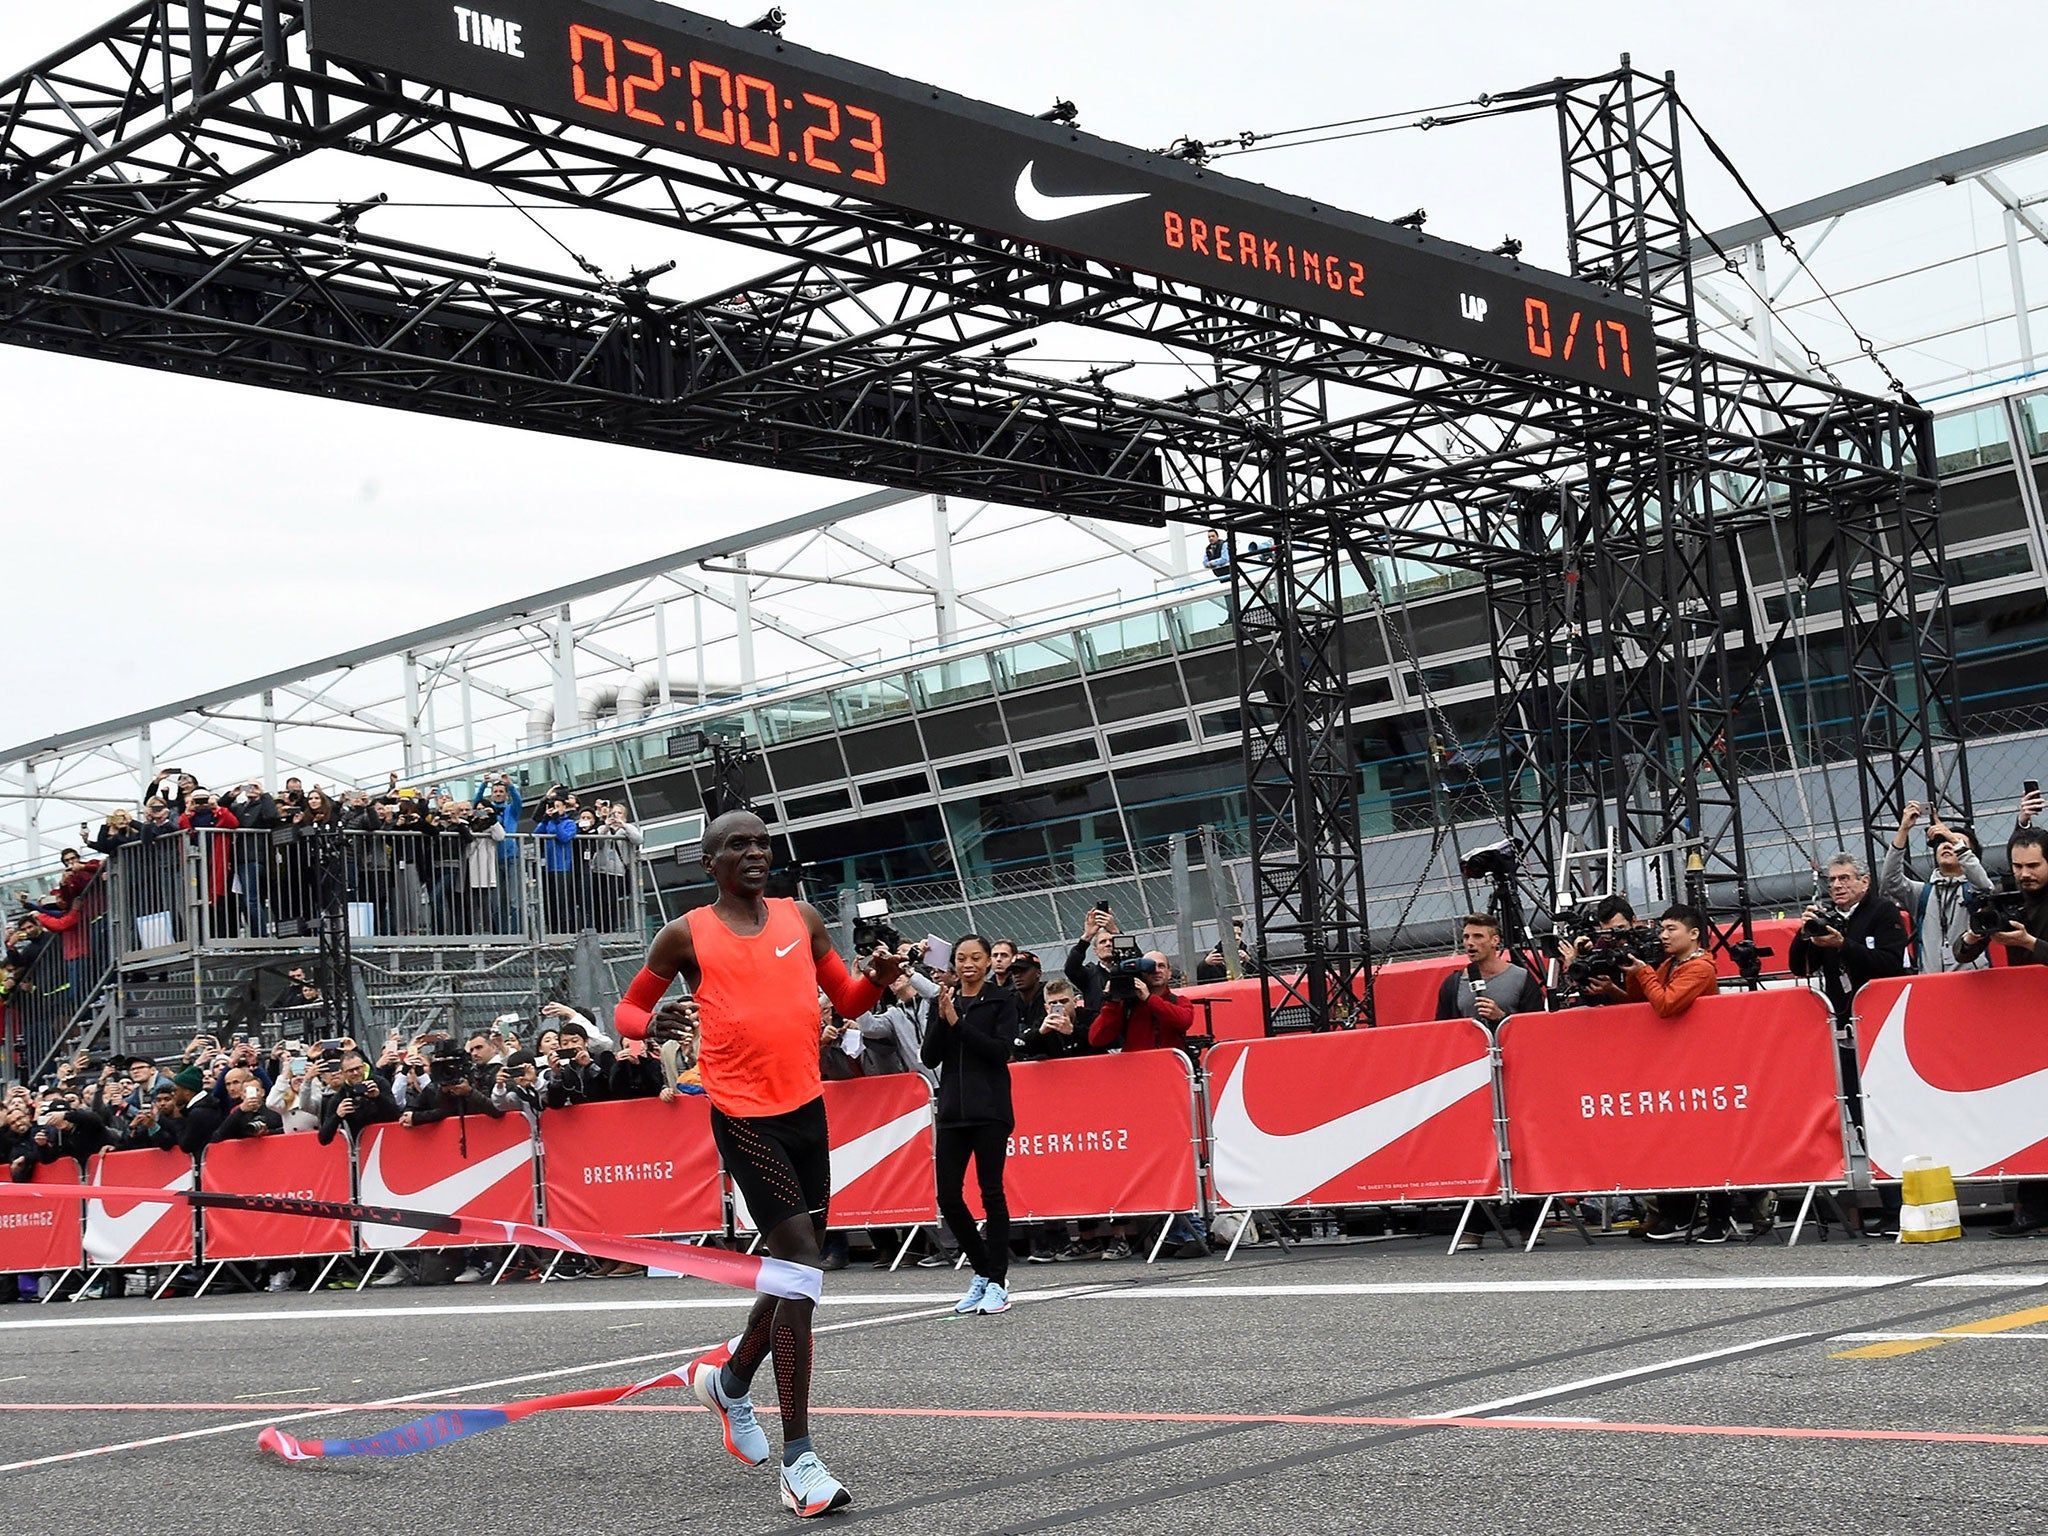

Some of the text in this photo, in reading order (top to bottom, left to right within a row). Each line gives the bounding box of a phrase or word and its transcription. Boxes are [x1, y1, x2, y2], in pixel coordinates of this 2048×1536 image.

[453, 5, 887, 186] TIME 02:00:23
[1164, 210, 1366, 298] BREAKING2
[1460, 292, 1632, 378] LAP 0/17
[1649, 855, 1664, 901] 1
[1580, 1084, 1748, 1119] BREAKING2
[1005, 1129, 1128, 1157] BREAKING2
[583, 1161, 674, 1185] BREAKING2
